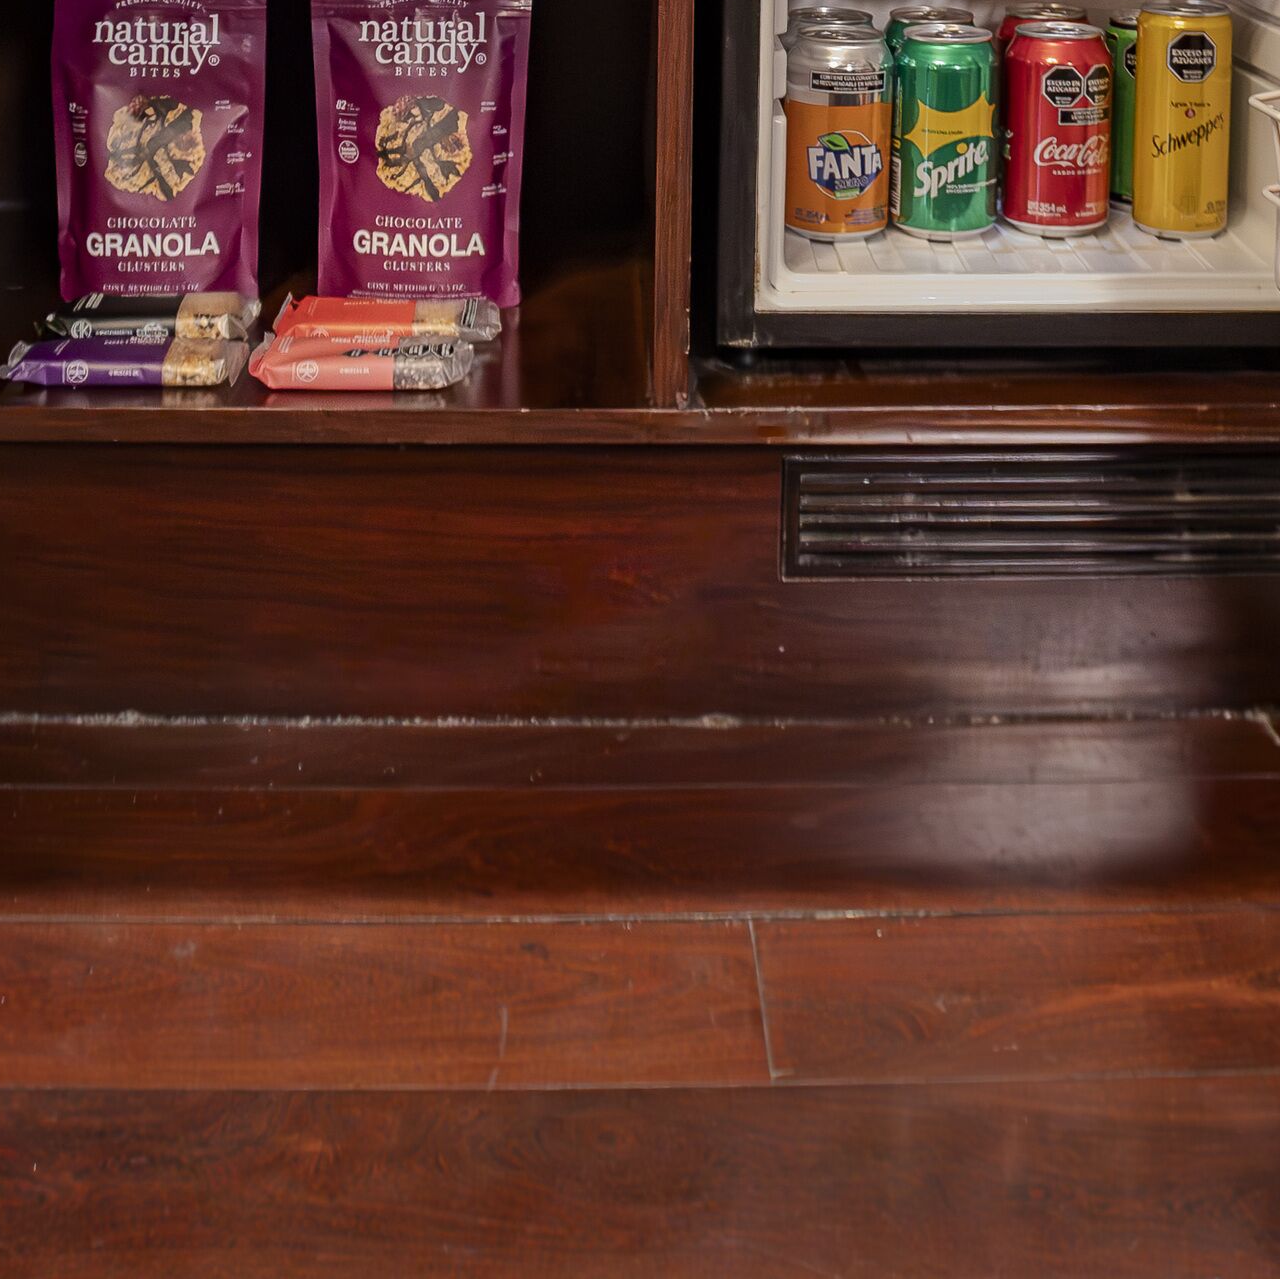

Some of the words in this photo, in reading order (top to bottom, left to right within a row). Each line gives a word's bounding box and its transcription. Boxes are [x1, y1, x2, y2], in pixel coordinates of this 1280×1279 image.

[92, 13, 221, 45] natural
[358, 11, 488, 43] natural
[108, 30, 213, 75] candy
[375, 28, 479, 73] candy
[129, 67, 181, 78] BITES
[395, 66, 448, 77] BITES
[808, 144, 882, 180] FANTA
[913, 140, 989, 199] Sprite
[107, 216, 197, 229] CHOCOLATE
[375, 215, 463, 229] CHOCOLATE
[86, 231, 220, 258] GRANOLA
[352, 229, 486, 258] GRANOLA
[117, 261, 185, 272] CLUSTERS
[383, 260, 451, 272] CLUSTERS
